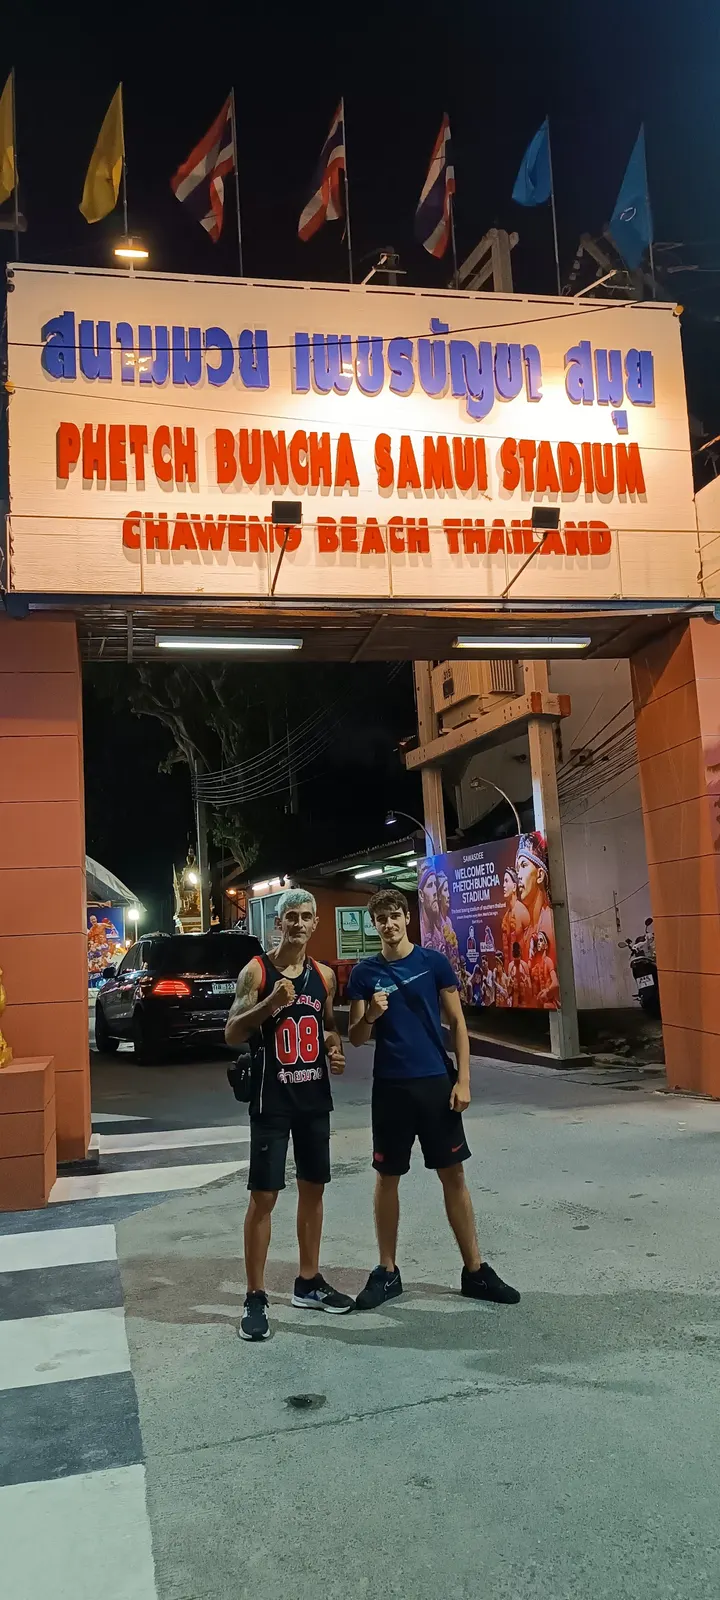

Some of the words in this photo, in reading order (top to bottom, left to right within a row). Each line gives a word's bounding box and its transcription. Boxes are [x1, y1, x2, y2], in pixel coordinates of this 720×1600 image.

[41, 311, 270, 389] สนามมวย
[294, 318, 542, 420] เพชรบัญชา
[565, 340, 655, 435] สมุย
[56, 422, 197, 483] PHETCH
[215, 428, 360, 488] BUNCHA
[374, 433, 488, 492] SAMUI
[501, 437, 647, 496] STADIUM
[123, 510, 302, 554] CHAWENG
[317, 516, 430, 554] BEACH
[443, 518, 612, 556] THAILAND
[455, 864, 485, 880] WELCOME
[485, 862, 495, 874] TO
[462, 851, 484, 862] SAWASDEE
[452, 879, 474, 892] PHETCH
[474, 874, 500, 890] BUNCHA
[462, 889, 490, 903] STADIUM
[274, 1014, 320, 1066] 08
